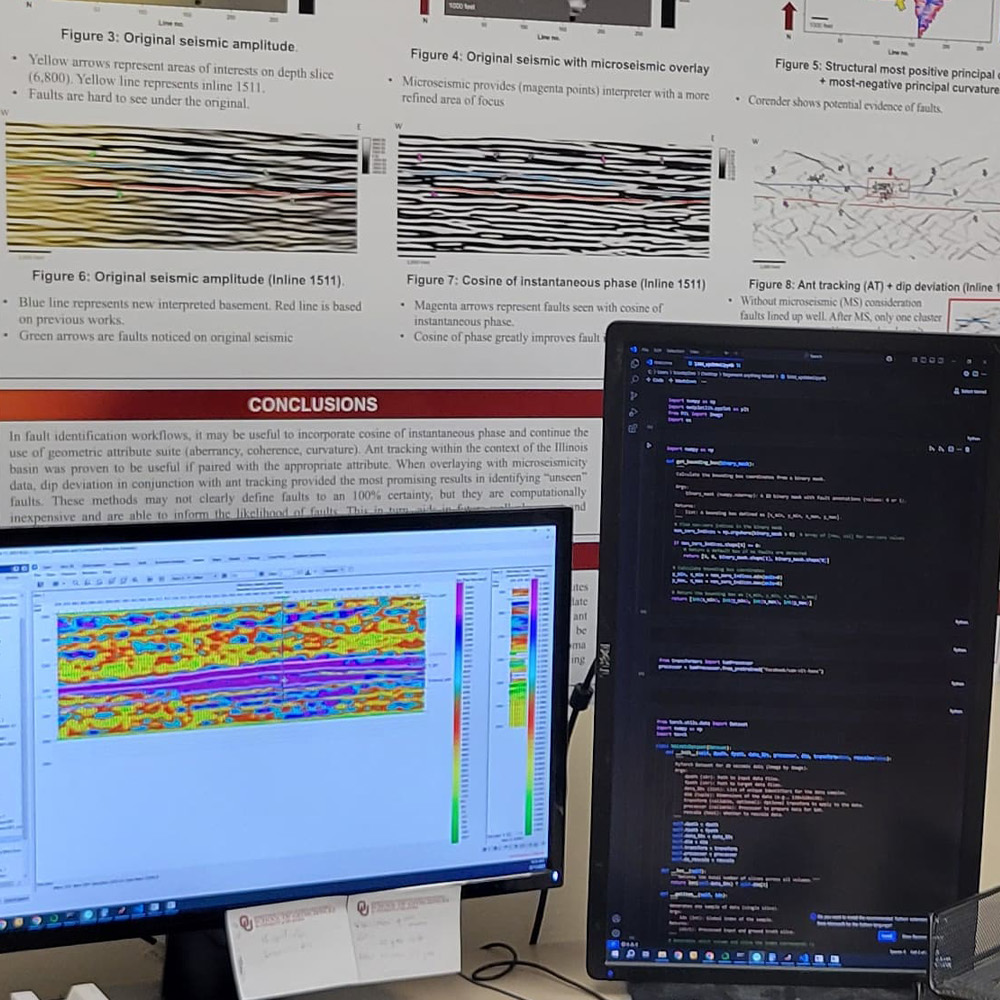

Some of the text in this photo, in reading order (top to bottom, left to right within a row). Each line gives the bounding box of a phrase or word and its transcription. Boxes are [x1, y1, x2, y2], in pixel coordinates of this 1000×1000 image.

[60, 27, 104, 43] Figure
[106, 30, 120, 42] 3:
[123, 31, 176, 47] Original
[178, 35, 229, 48] seismic
[28, 53, 334, 81] Yellow arrows represent areas of interests on depth slice
[410, 47, 710, 76] Figure 4: Original seismic with microseismic overlay
[775, 57, 810, 71] Figure
[811, 59, 822, 70] 5:
[824, 60, 877, 73] Structural
[879, 65, 906, 75] most
[908, 65, 949, 78] positive
[951, 67, 995, 81] principal
[76, 72, 116, 85] Yellow
[119, 74, 140, 87] line
[143, 79, 198, 91] represents
[202, 79, 232, 91] inline
[828, 77, 902, 91] most-negative
[904, 80, 950, 94] principal
[28, 88, 64, 100] Faults
[66, 92, 84, 101] are
[86, 90, 112, 103] hard
[114, 93, 127, 103] to
[128, 95, 148, 104] see
[150, 94, 183, 106] under
[184, 95, 202, 107] the
[401, 91, 505, 107] refined area of focus
[31, 269, 75, 284] Figure
[78, 270, 90, 282] 6:
[94, 270, 146, 285] Original
[149, 271, 199, 283] seismic
[202, 272, 264, 287] amplitude
[267, 273, 306, 287] (Inline
[406, 273, 706, 291] Figure 7: Cosine of instantaneous phase (Inline 1511)
[748, 278, 783, 291] Figure
[784, 279, 795, 289] 8:
[796, 279, 816, 290] Ant
[818, 280, 861, 293] tracking
[863, 280, 884, 293] (AT)
[895, 280, 912, 293] dip
[914, 281, 960, 292] deviation
[962, 282, 993, 294] (Inline
[18, 296, 46, 307] Blue
[48, 296, 70, 308] line
[71, 299, 130, 311] represents
[131, 300, 156, 309] new
[157, 298, 216, 312] interpreted
[274, 299, 296, 311] Red
[298, 300, 318, 311] line
[320, 300, 330, 311] is
[332, 300, 362, 311] based
[413, 299, 664, 314] Magenta arrows represent faults seen with cosine of
[18, 315, 33, 324] on
[36, 313, 85, 327] previous
[413, 315, 482, 326] instantaneous
[18, 329, 294, 345] Green arrows are faults noticed on original seismic
[247, 396, 378, 412] CONCLUSIONS
[8, 430, 21, 442] In
[24, 429, 50, 442] fault
[54, 429, 128, 442] identification
[194, 429, 202, 440] it
[204, 431, 229, 443] may
[232, 428, 246, 440] be
[248, 427, 280, 440] useful
[283, 430, 294, 439] to
[297, 428, 356, 442] incorporate
[358, 427, 391, 439] cosine
[393, 427, 406, 438] of
[408, 427, 475, 438] instantaneous
[477, 427, 506, 440] phase
[508, 426, 526, 437] and
[529, 427, 571, 437] continue
[573, 426, 589, 437] the
[9, 449, 28, 458] use
[31, 445, 45, 458] of
[47, 446, 102, 461] geometric
[106, 445, 152, 457] attribute
[155, 444, 181, 457] suite
[364, 443, 383, 454] Ant
[386, 443, 428, 456] tracking
[430, 442, 462, 453] within
[466, 442, 481, 453] the
[484, 444, 519, 453] context
[522, 441, 534, 452] of
[536, 442, 551, 452] the
[555, 441, 588, 452] Illinois
